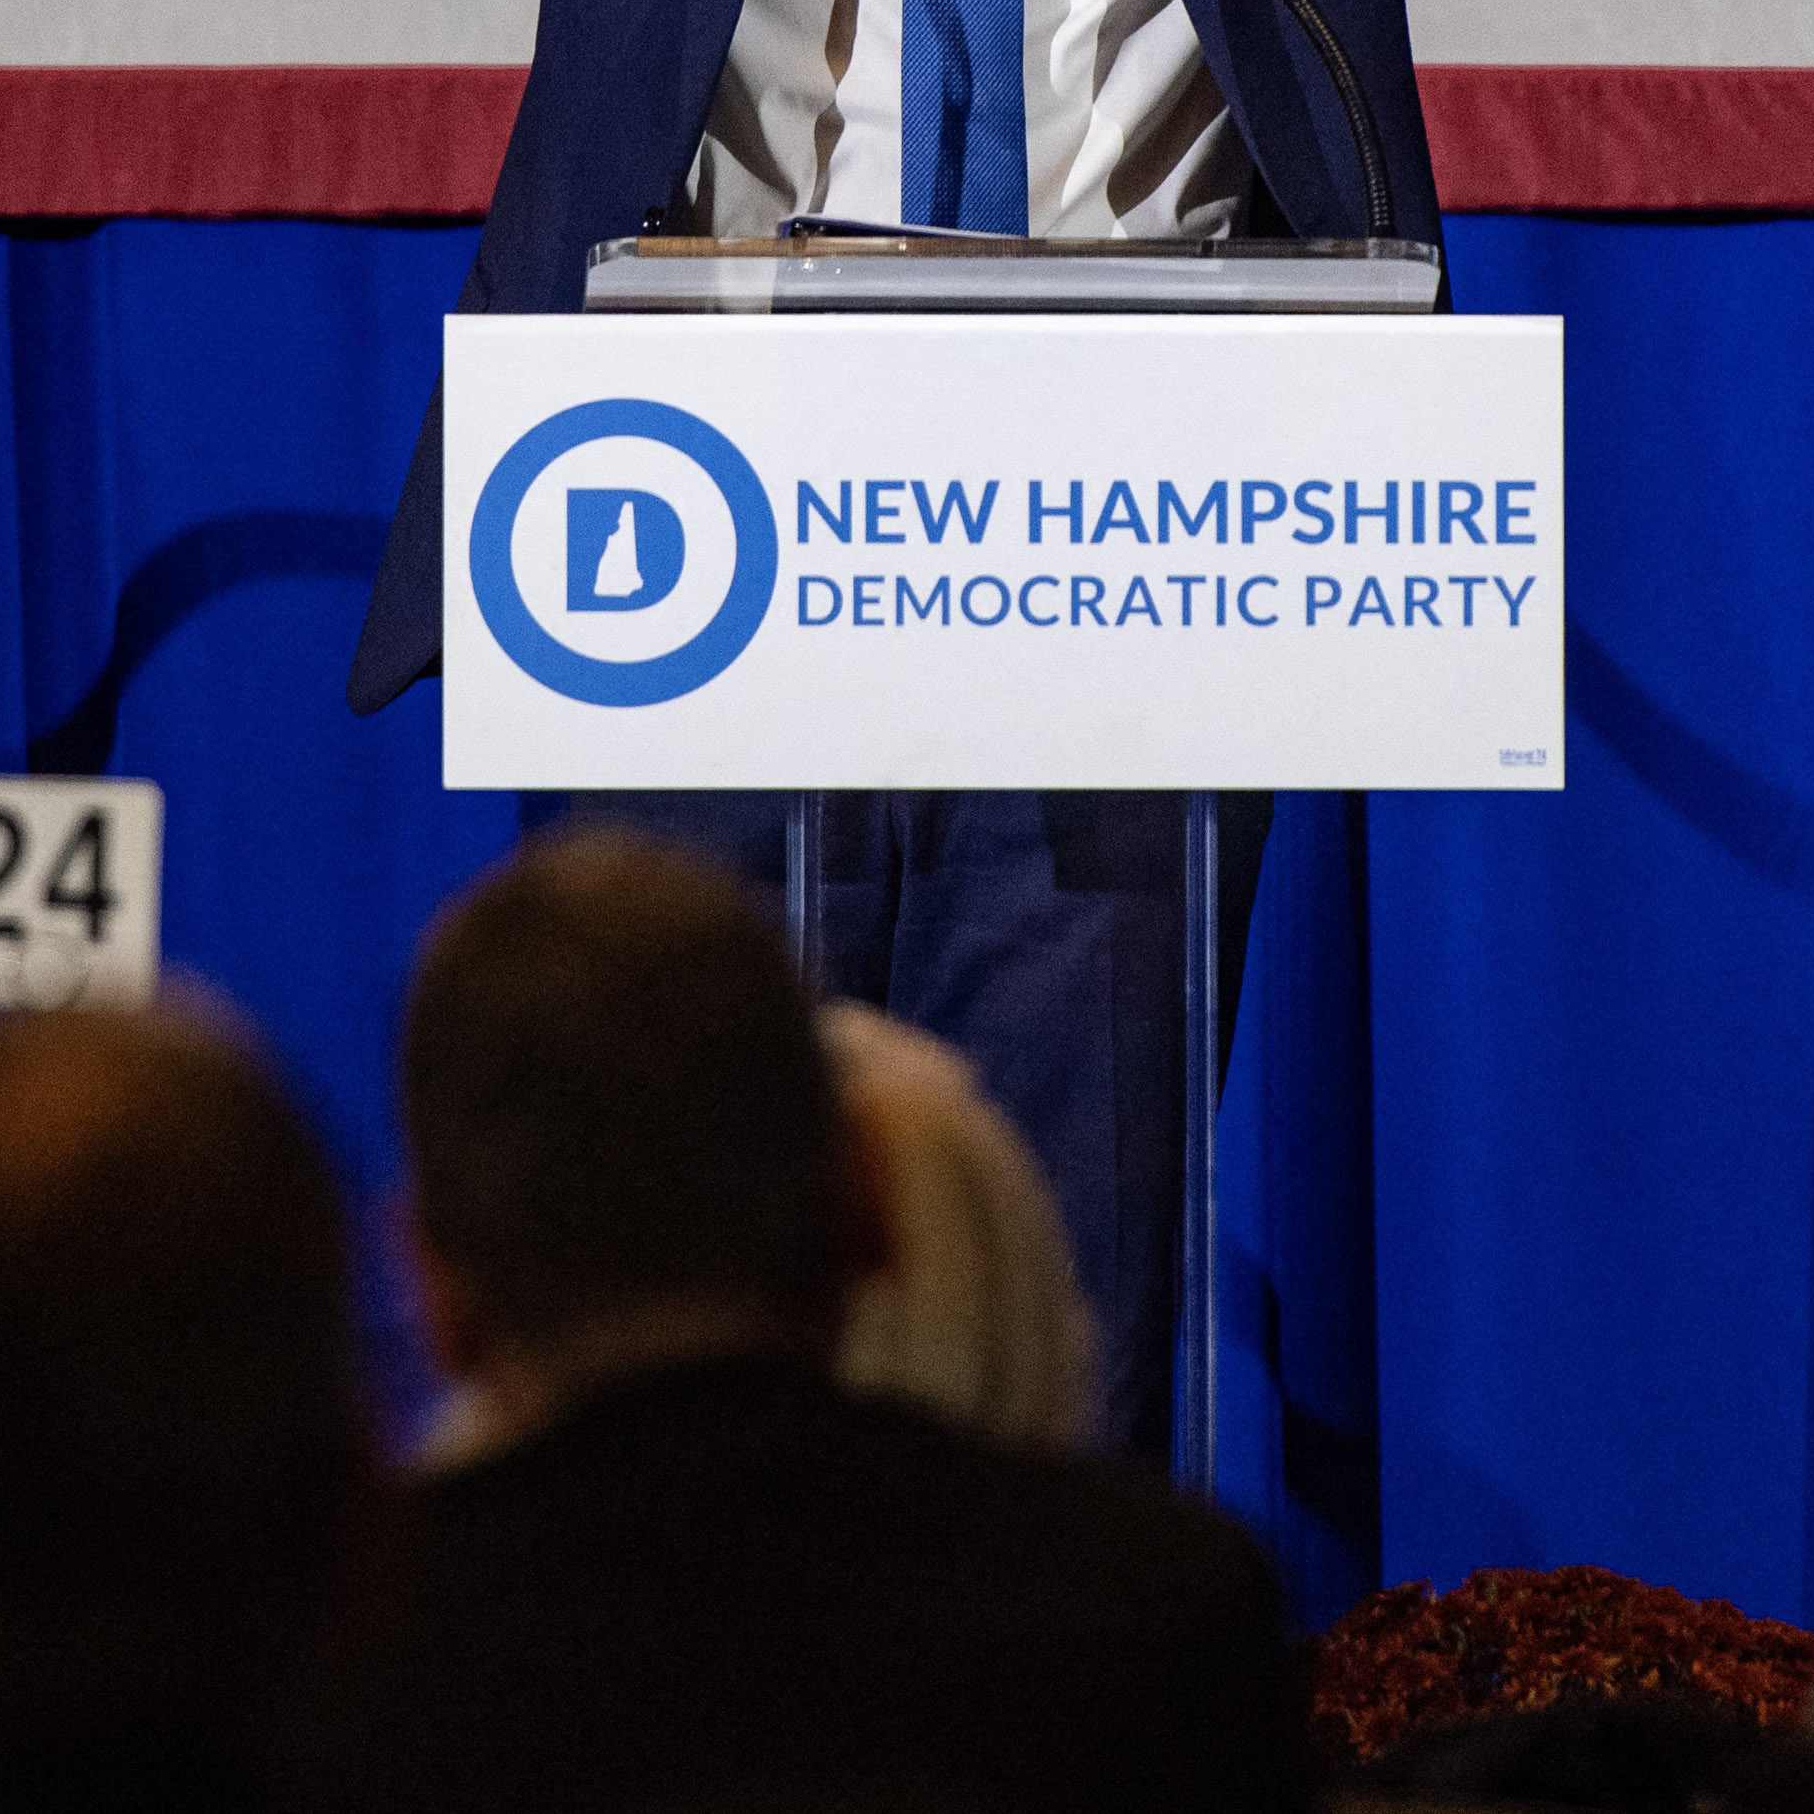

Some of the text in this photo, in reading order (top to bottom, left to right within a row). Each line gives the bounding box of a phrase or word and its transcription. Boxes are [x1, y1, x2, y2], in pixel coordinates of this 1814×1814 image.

[797, 479, 1536, 545] NEW HAMPSHIRE
[567, 487, 686, 613] D
[798, 574, 1536, 628] DEMOCRATIC PARTY
